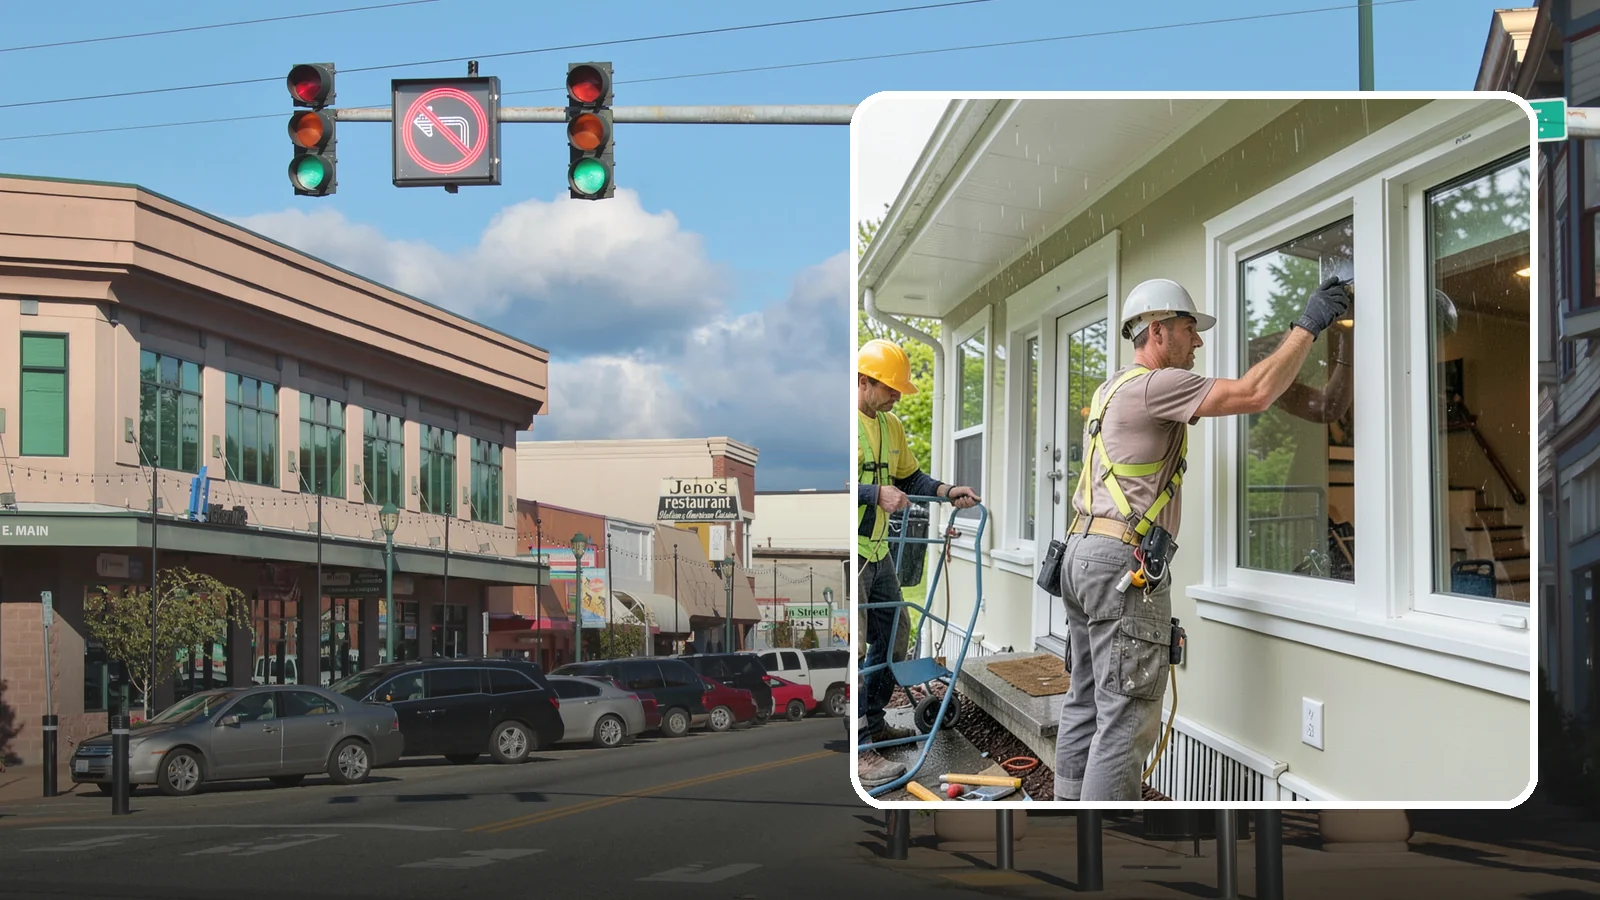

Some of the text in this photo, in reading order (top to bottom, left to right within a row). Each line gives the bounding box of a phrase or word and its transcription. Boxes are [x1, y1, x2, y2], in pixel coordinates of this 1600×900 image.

[670, 480, 727, 494] Jeno's
[665, 497, 731, 509] restaurant
[686, 510, 714, 519] American
[715, 510, 737, 519] Cuisine
[2, 525, 49, 536] E. MAIN
[797, 608, 828, 616] Street
[791, 619, 823, 627] lass
